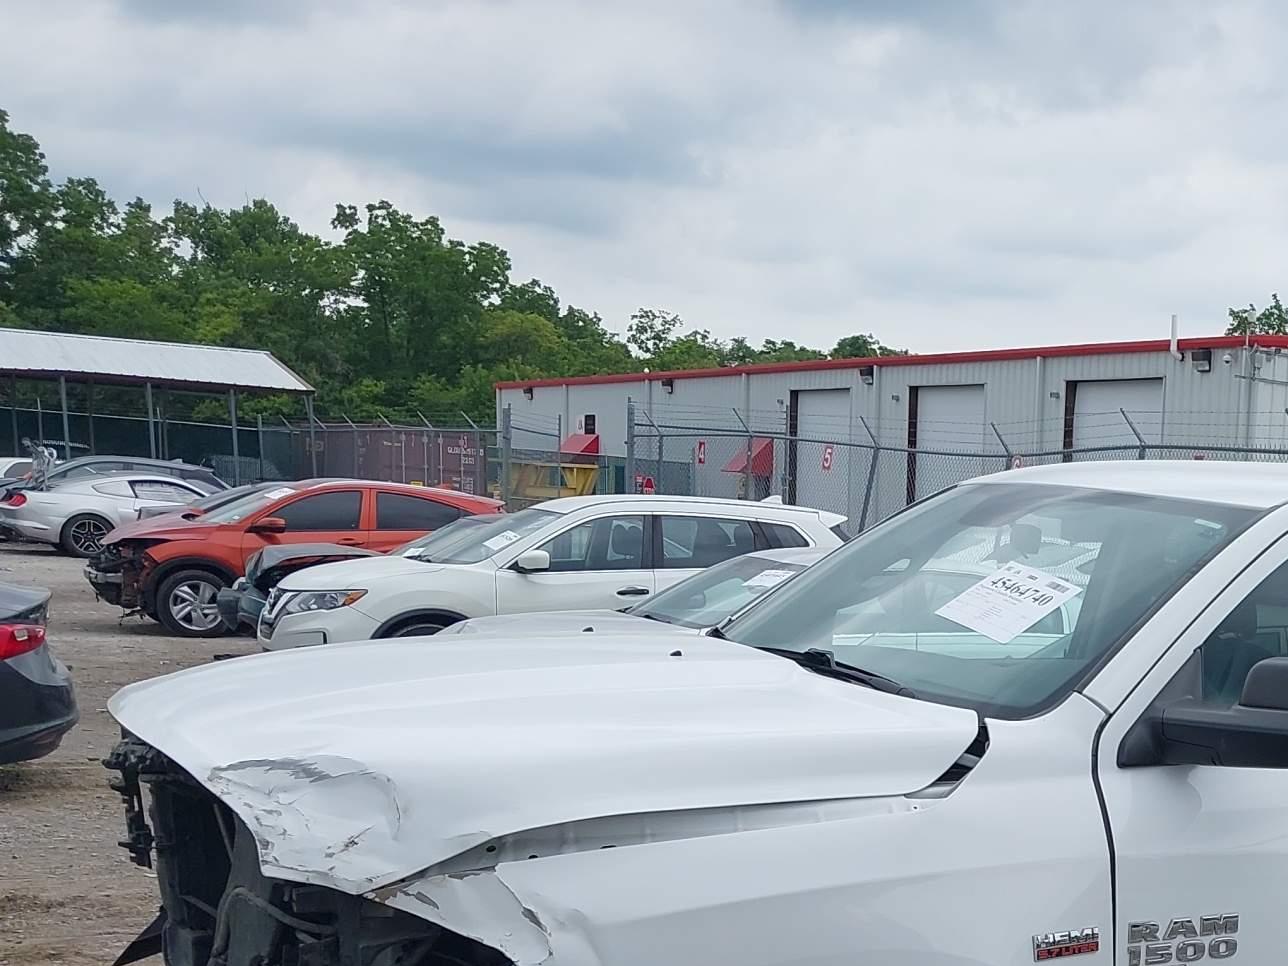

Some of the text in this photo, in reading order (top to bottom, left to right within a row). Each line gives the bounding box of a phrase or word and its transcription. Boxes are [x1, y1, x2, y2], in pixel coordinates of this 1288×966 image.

[823, 448, 832, 467] 5
[991, 576, 1054, 606] 45464740
[1035, 927, 1099, 948] HEMI
[1127, 913, 1239, 944] RAM
